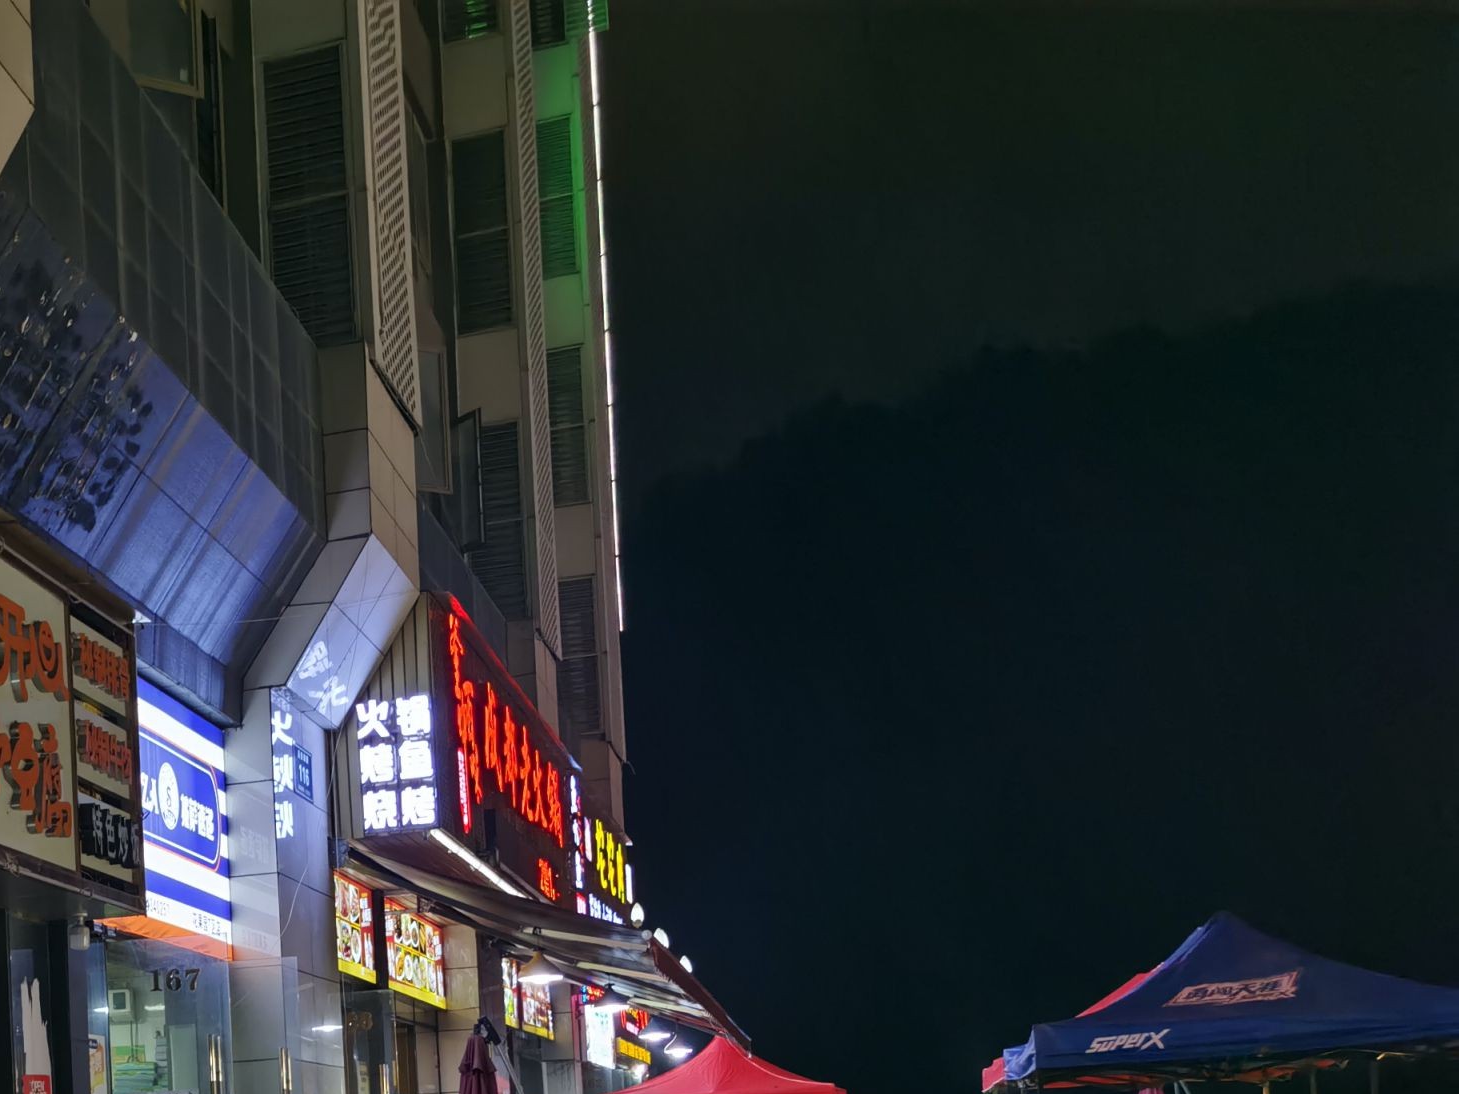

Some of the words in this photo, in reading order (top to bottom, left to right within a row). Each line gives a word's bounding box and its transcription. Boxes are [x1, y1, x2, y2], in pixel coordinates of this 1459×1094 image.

[355, 695, 431, 738] 火锅
[360, 739, 434, 783] 烤鱼
[363, 785, 437, 831] 烧烤
[149, 967, 202, 993] 167
